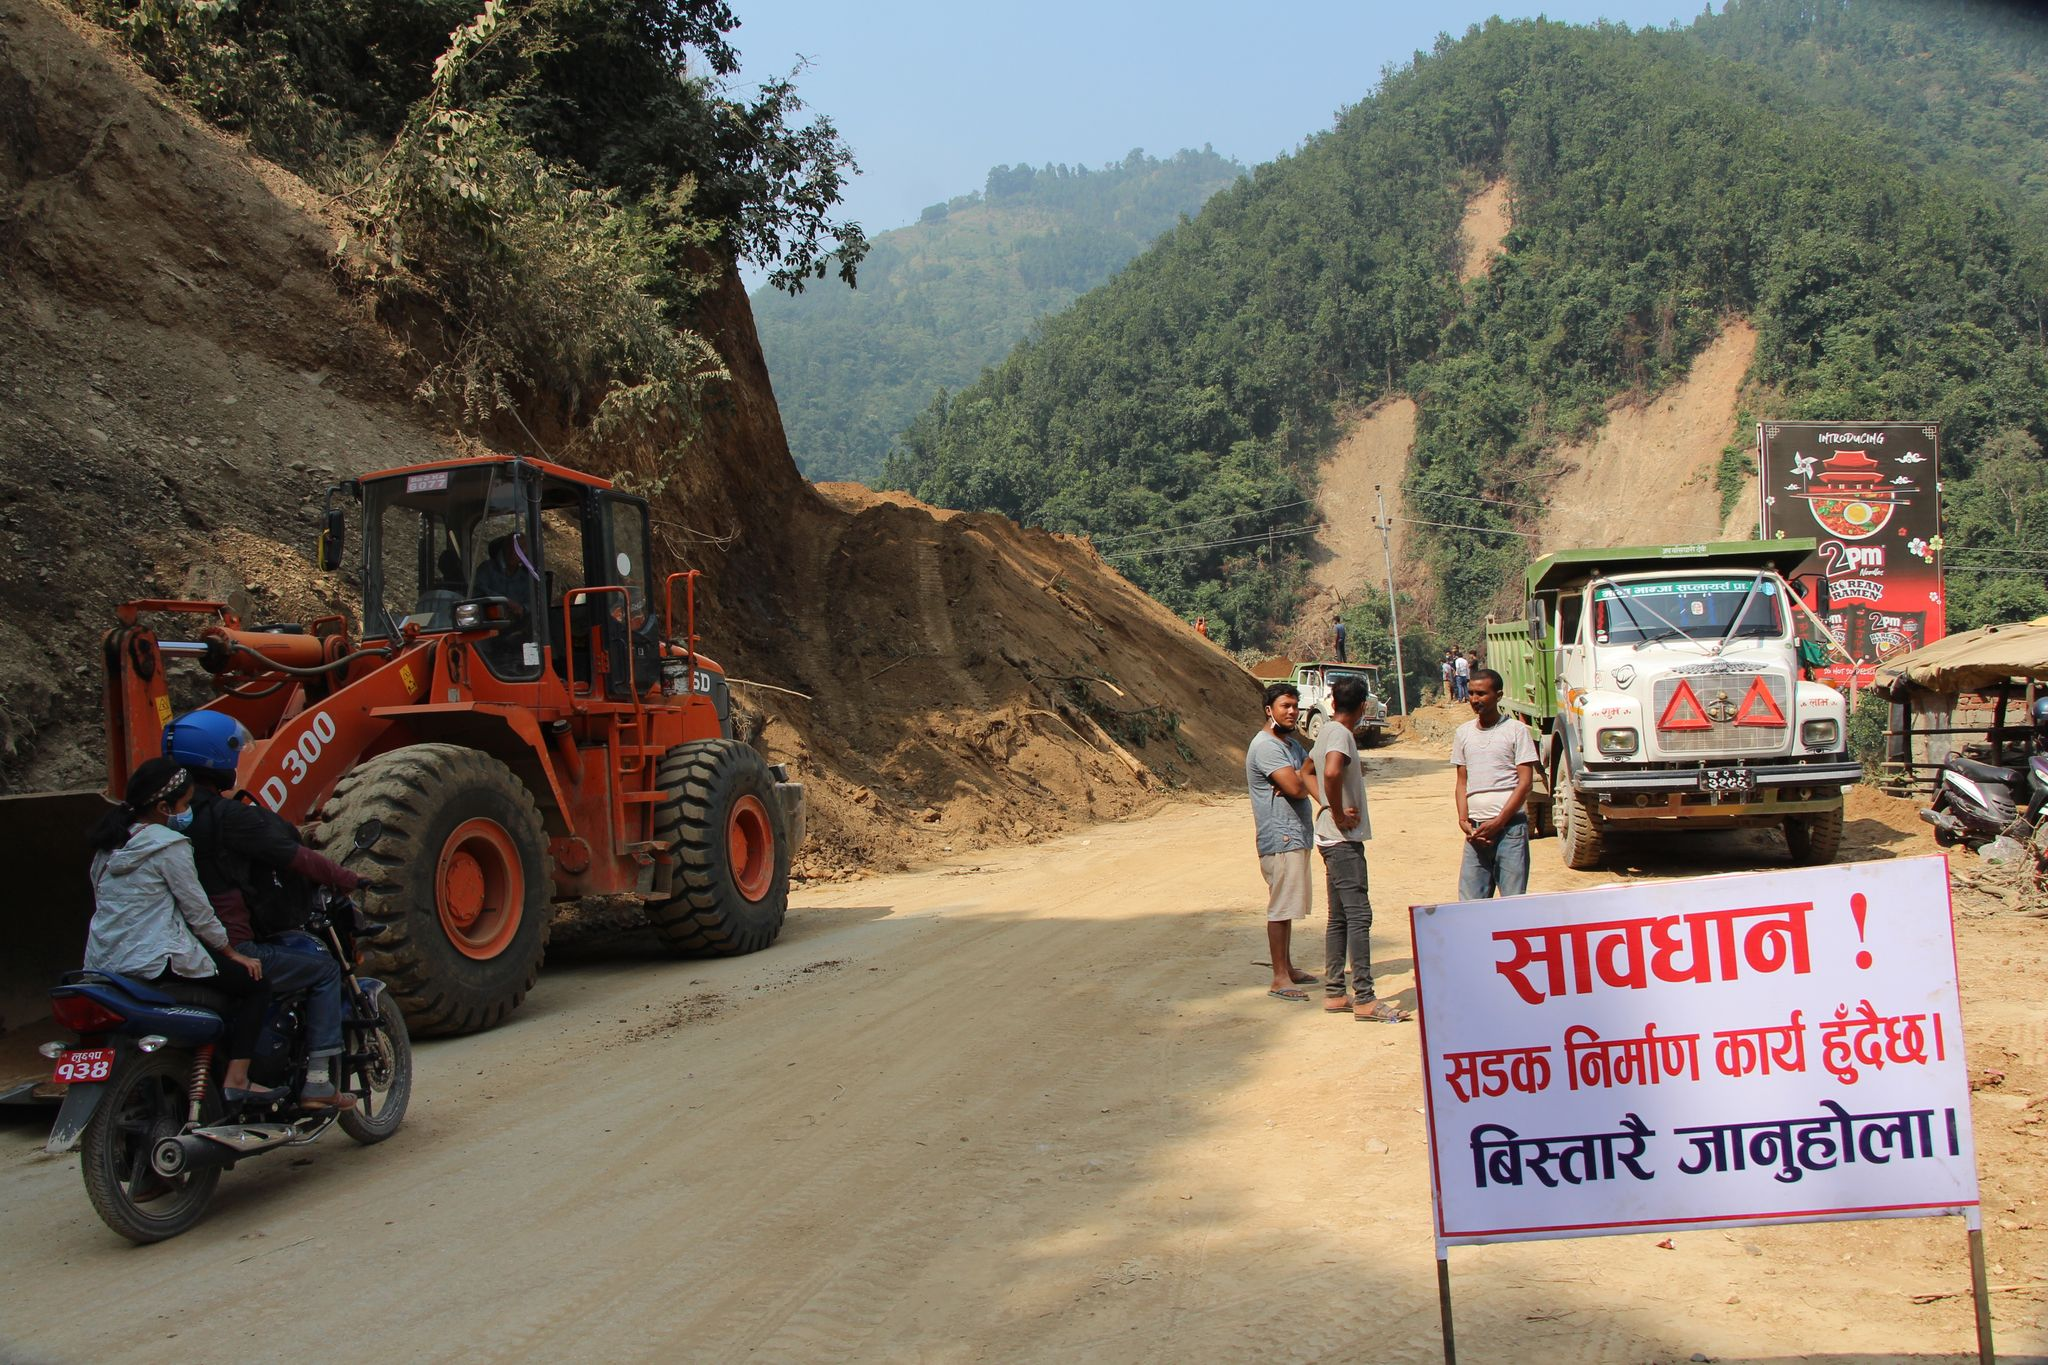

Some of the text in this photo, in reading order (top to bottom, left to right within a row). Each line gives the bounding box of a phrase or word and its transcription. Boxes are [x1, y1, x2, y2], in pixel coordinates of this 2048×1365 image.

[1818, 432, 1885, 445] INTRODUCING
[1818, 540, 1882, 577] 2pm
[1829, 579, 1883, 593] KOREAN
[1831, 588, 1881, 601] RAMEN
[282, 711, 336, 785] 300
[1492, 892, 1873, 1005] सावधान !
[58, 1061, 109, 1080] १३४
[1443, 1045, 1551, 1104] सडक
[1564, 1022, 1701, 1090] निर्माण
[1712, 1009, 1807, 1078] कार्य
[1469, 1099, 1960, 1188] बिस्तारै जानुहोला।
